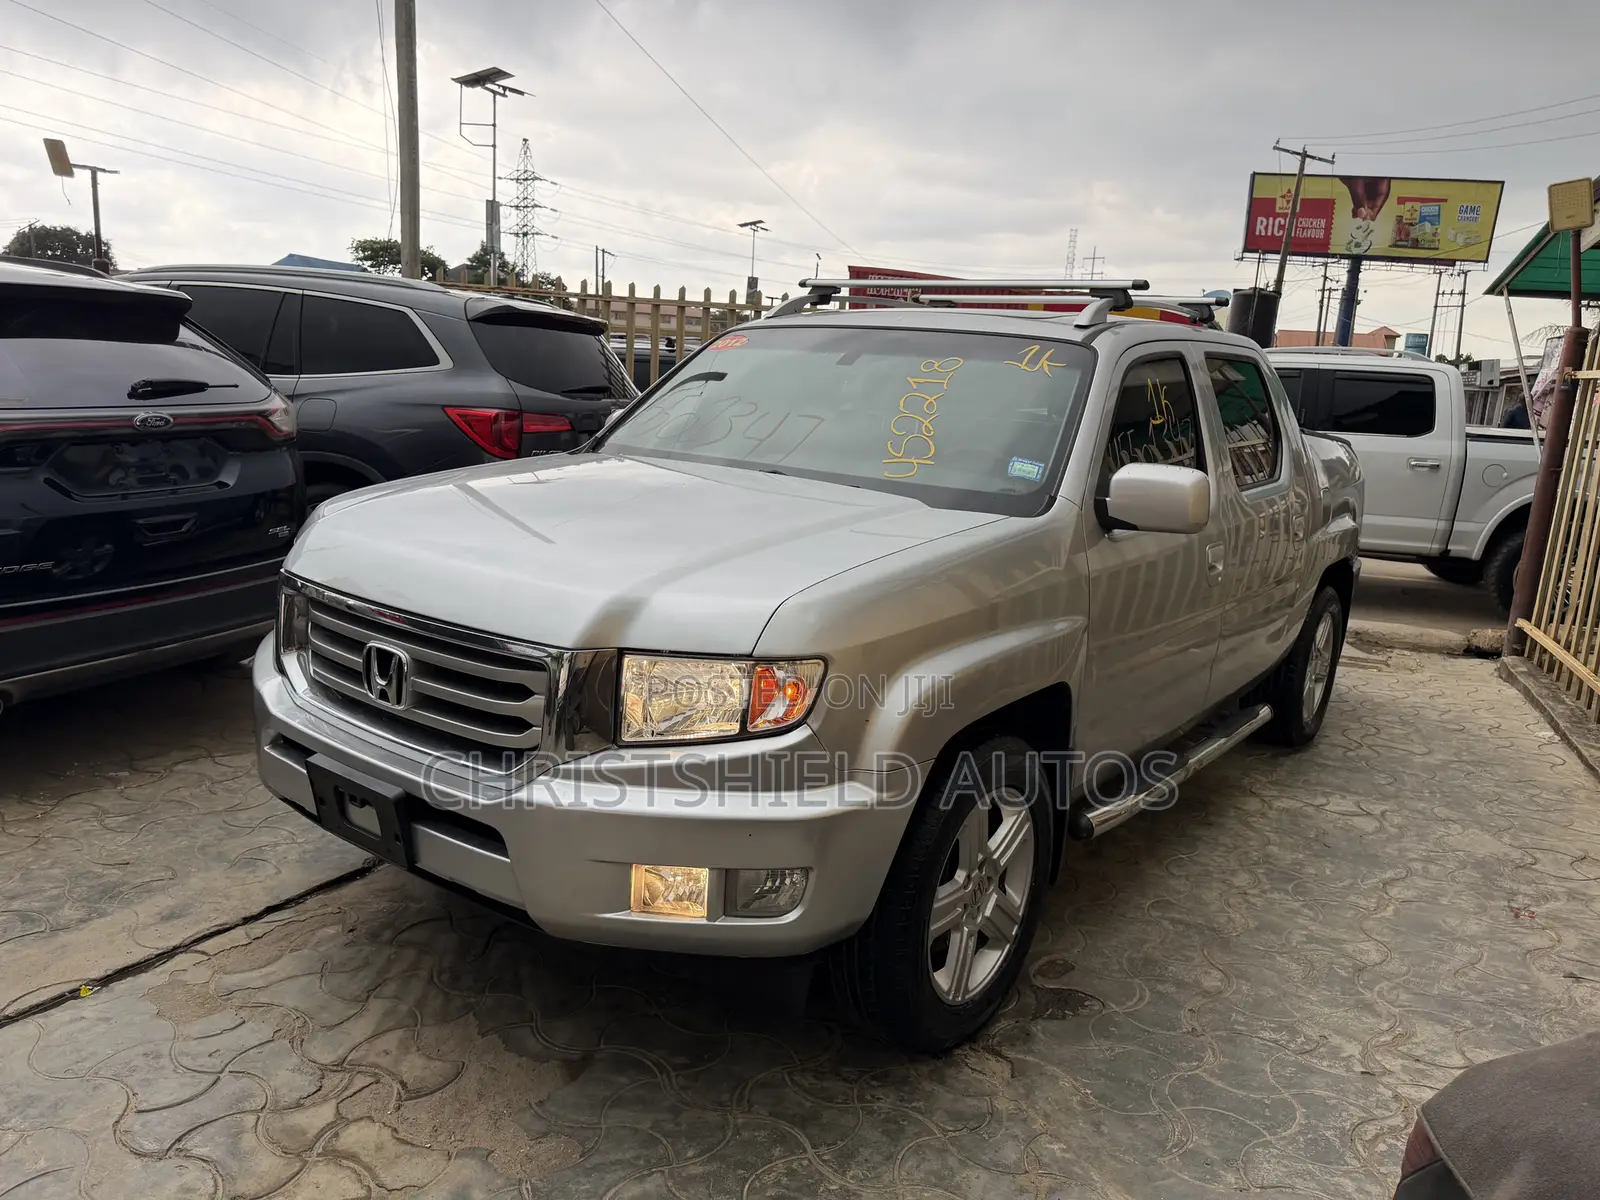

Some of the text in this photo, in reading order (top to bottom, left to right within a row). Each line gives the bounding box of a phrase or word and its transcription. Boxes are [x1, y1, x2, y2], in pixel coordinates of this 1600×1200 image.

[1458, 205, 1481, 216] GAME
[1297, 217, 1326, 229] CHICKEN
[1296, 228, 1325, 239] FLAVOUR
[0, 562, 55, 575] DGE
